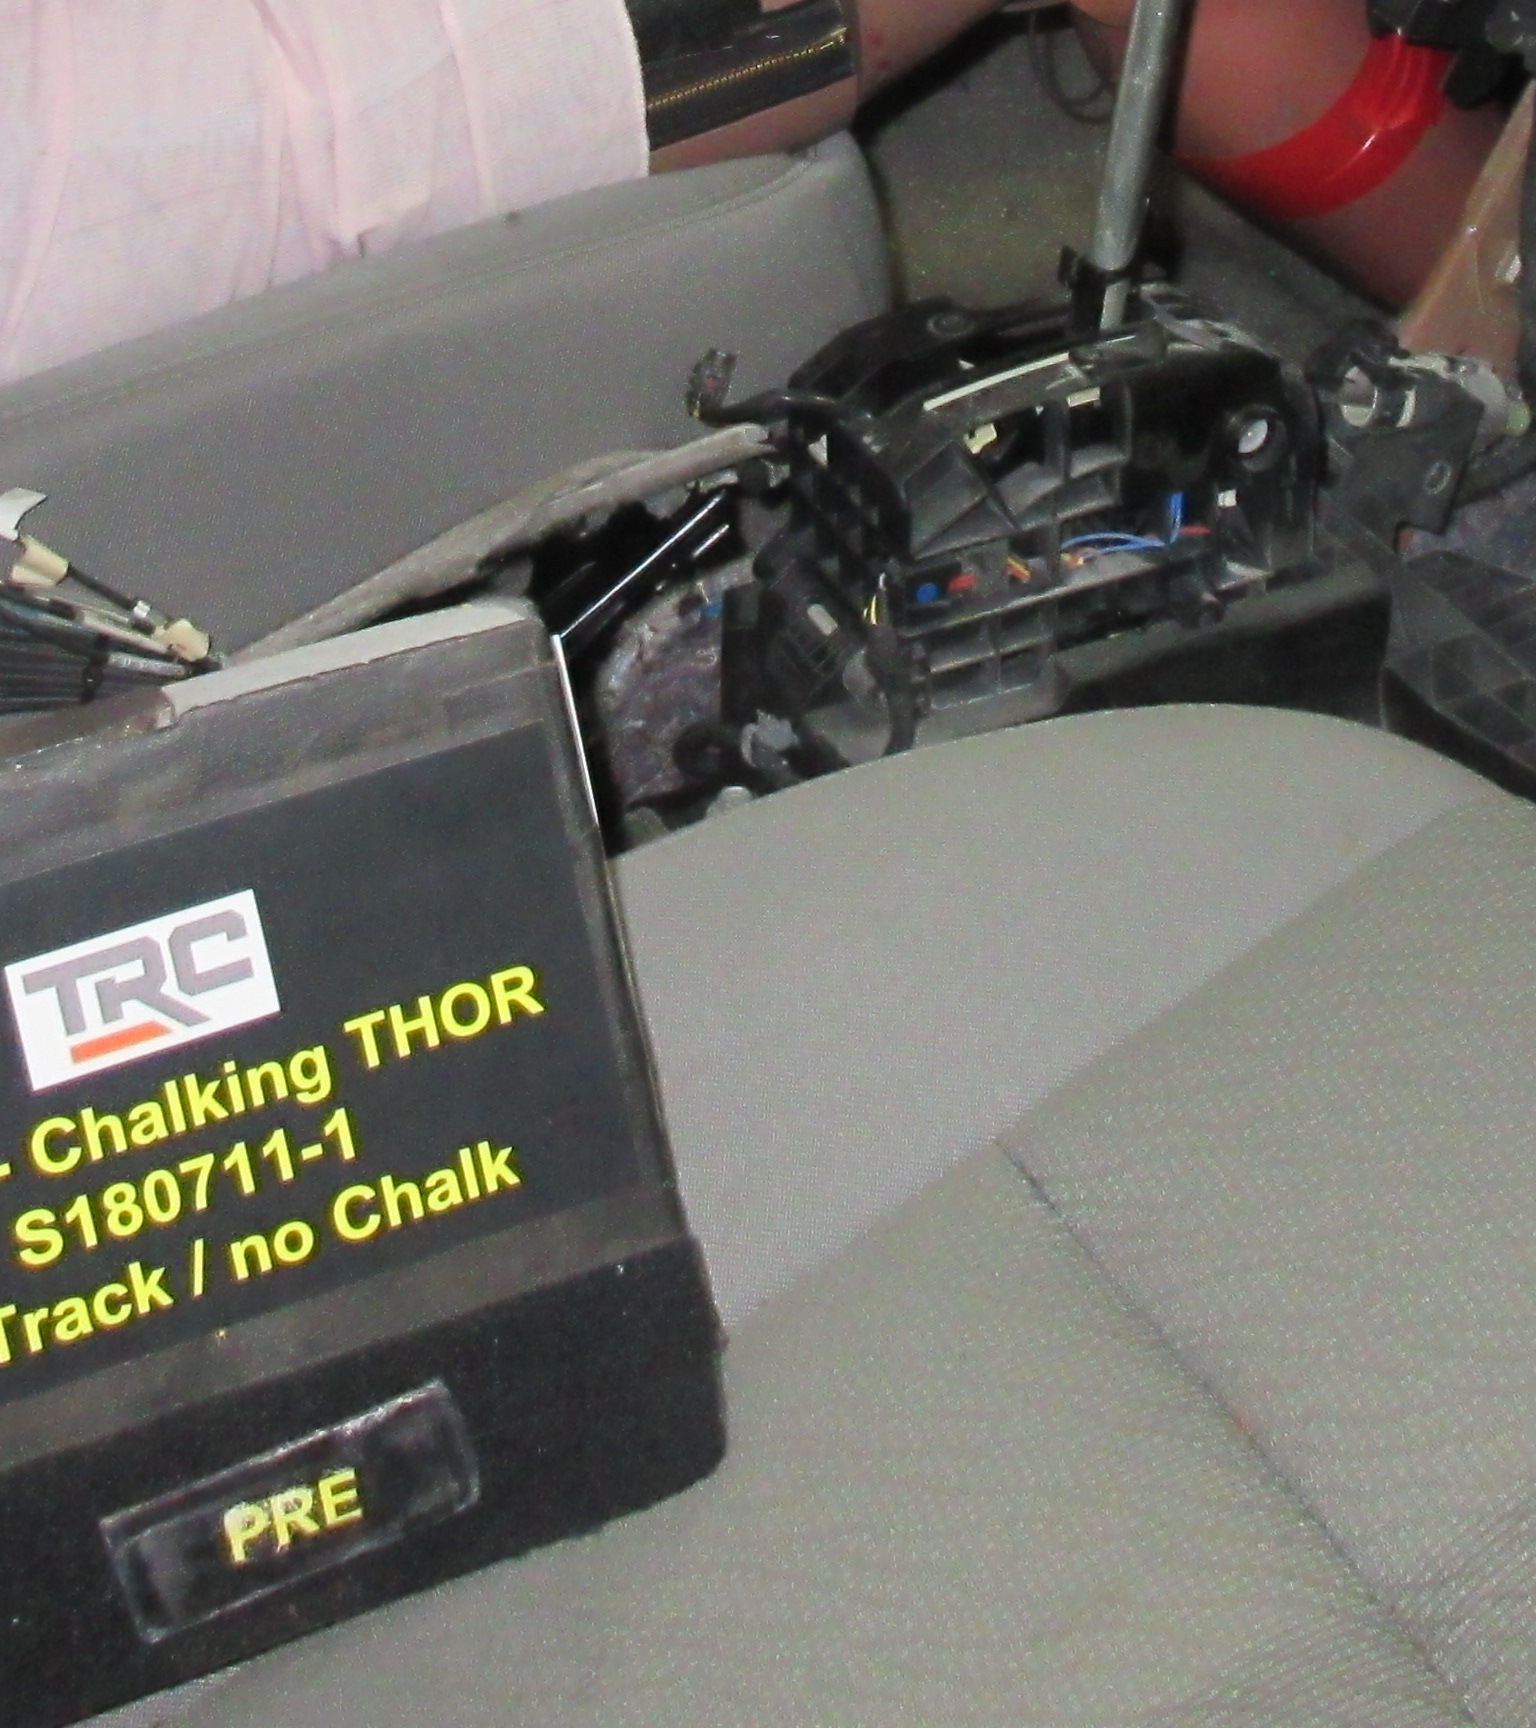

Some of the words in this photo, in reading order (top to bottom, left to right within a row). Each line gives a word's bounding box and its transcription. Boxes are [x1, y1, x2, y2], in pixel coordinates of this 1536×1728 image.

[21, 908, 256, 1037] TRC
[27, 1044, 332, 1176] Chalking
[343, 965, 545, 1070] THOR
[11, 1107, 357, 1268] S180711-1
[227, 1220, 315, 1280] no
[330, 1139, 522, 1243] Chalk
[222, 1467, 363, 1564] PRE
